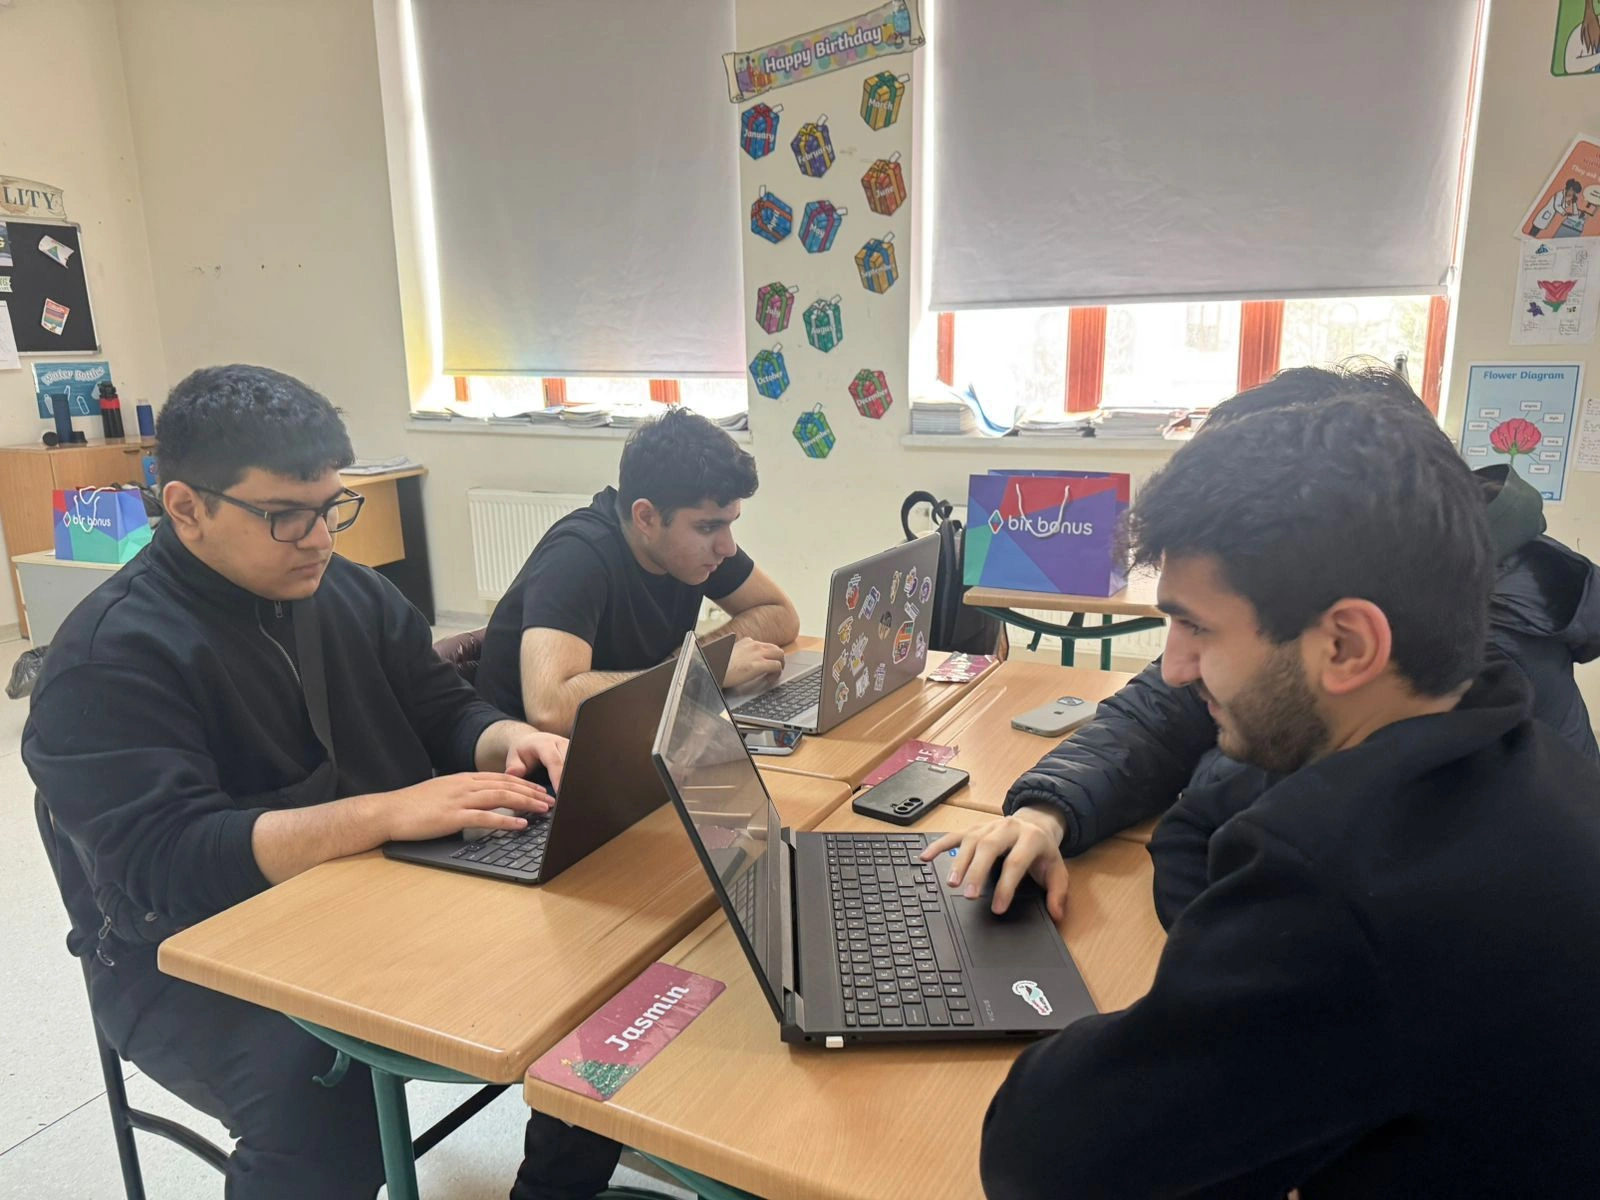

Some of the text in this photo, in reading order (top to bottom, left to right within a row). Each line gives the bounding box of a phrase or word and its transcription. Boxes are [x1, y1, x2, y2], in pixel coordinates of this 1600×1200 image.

[764, 26, 882, 73] Happy Birthday
[868, 99, 894, 111] March
[743, 129, 775, 142] January
[798, 144, 832, 163] February
[876, 187, 894, 197] June
[767, 210, 780, 231] April
[809, 224, 825, 239] May
[765, 307, 781, 318] July
[757, 371, 783, 385] October
[1483, 370, 1564, 382] Flower Diagram
[856, 388, 888, 407] December
[802, 429, 830, 448] November
[1008, 514, 1093, 535] bir bonus
[604, 985, 690, 1052] Jasmin
